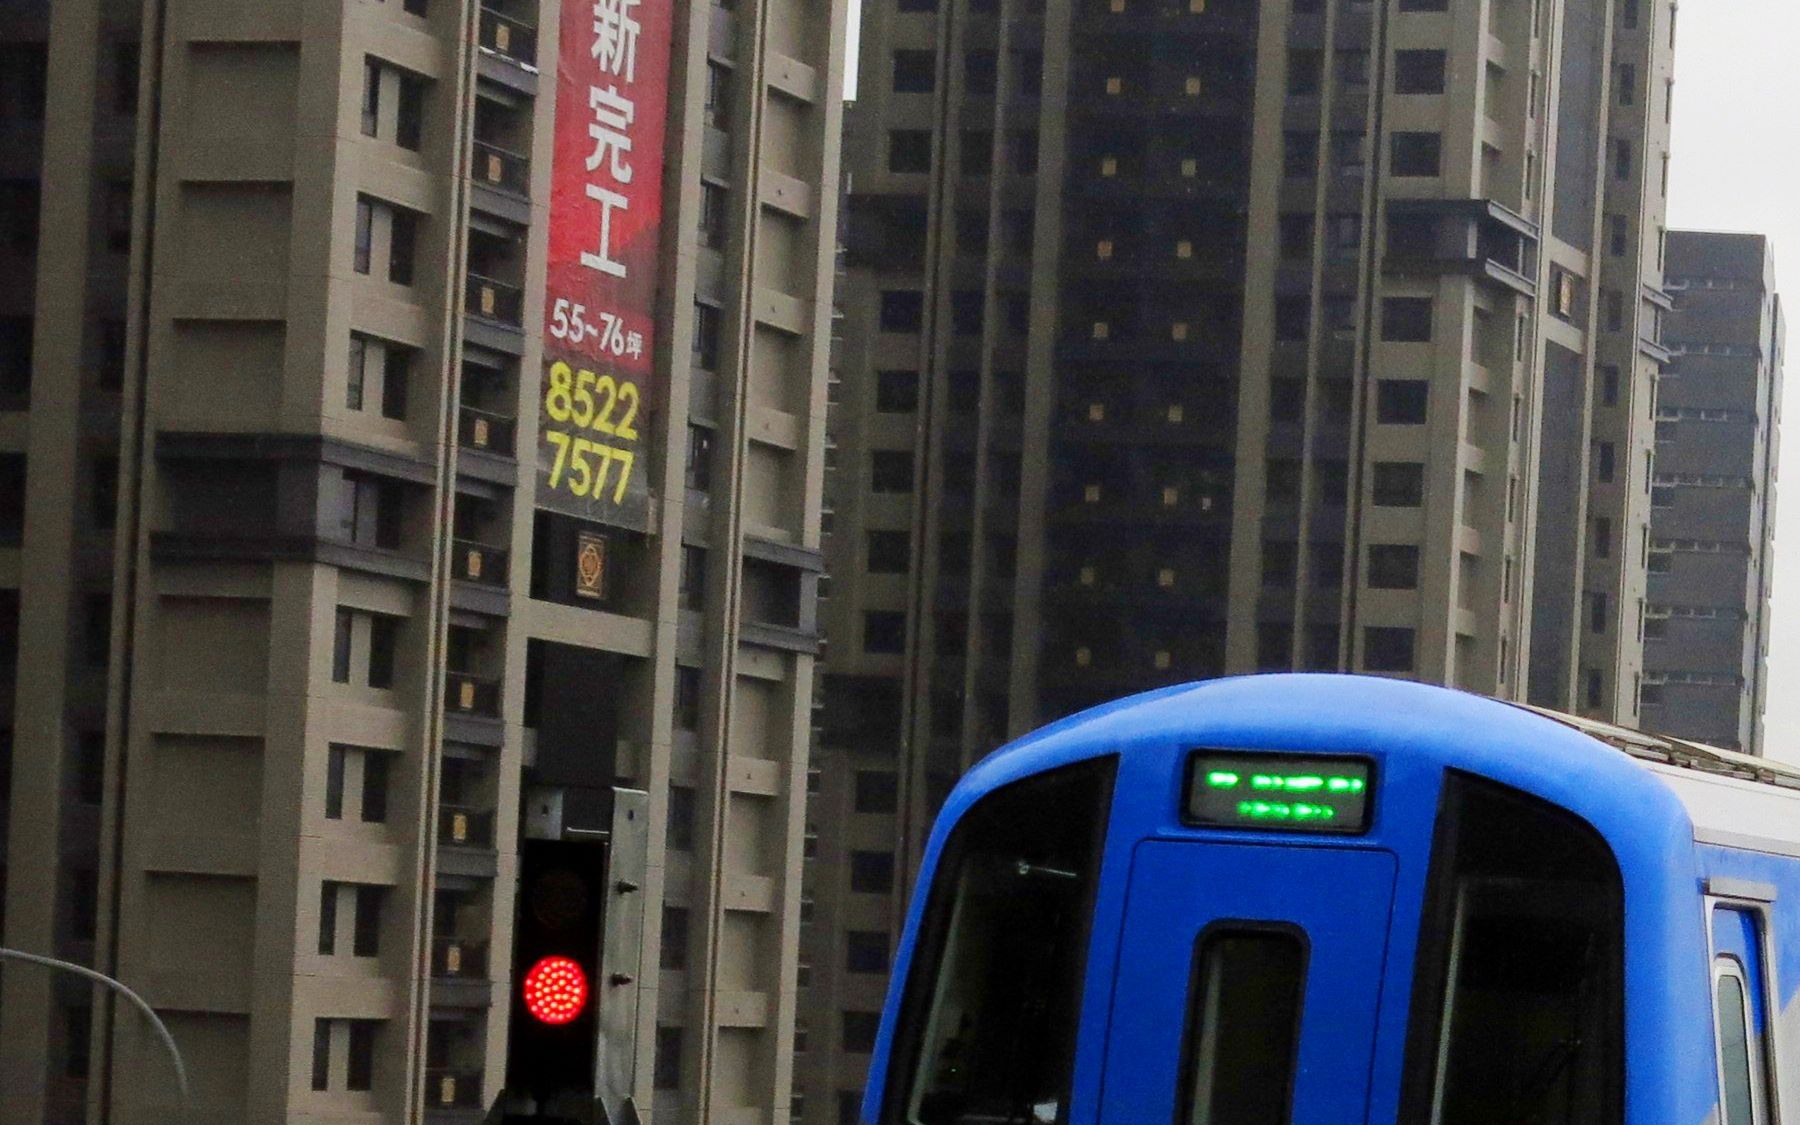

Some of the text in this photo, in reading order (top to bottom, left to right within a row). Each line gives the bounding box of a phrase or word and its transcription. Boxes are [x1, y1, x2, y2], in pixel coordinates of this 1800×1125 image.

[579, 0, 641, 279] 新完工
[549, 298, 643, 360] 55~76坪
[546, 361, 639, 441] 8522
[547, 431, 635, 505] 7577
